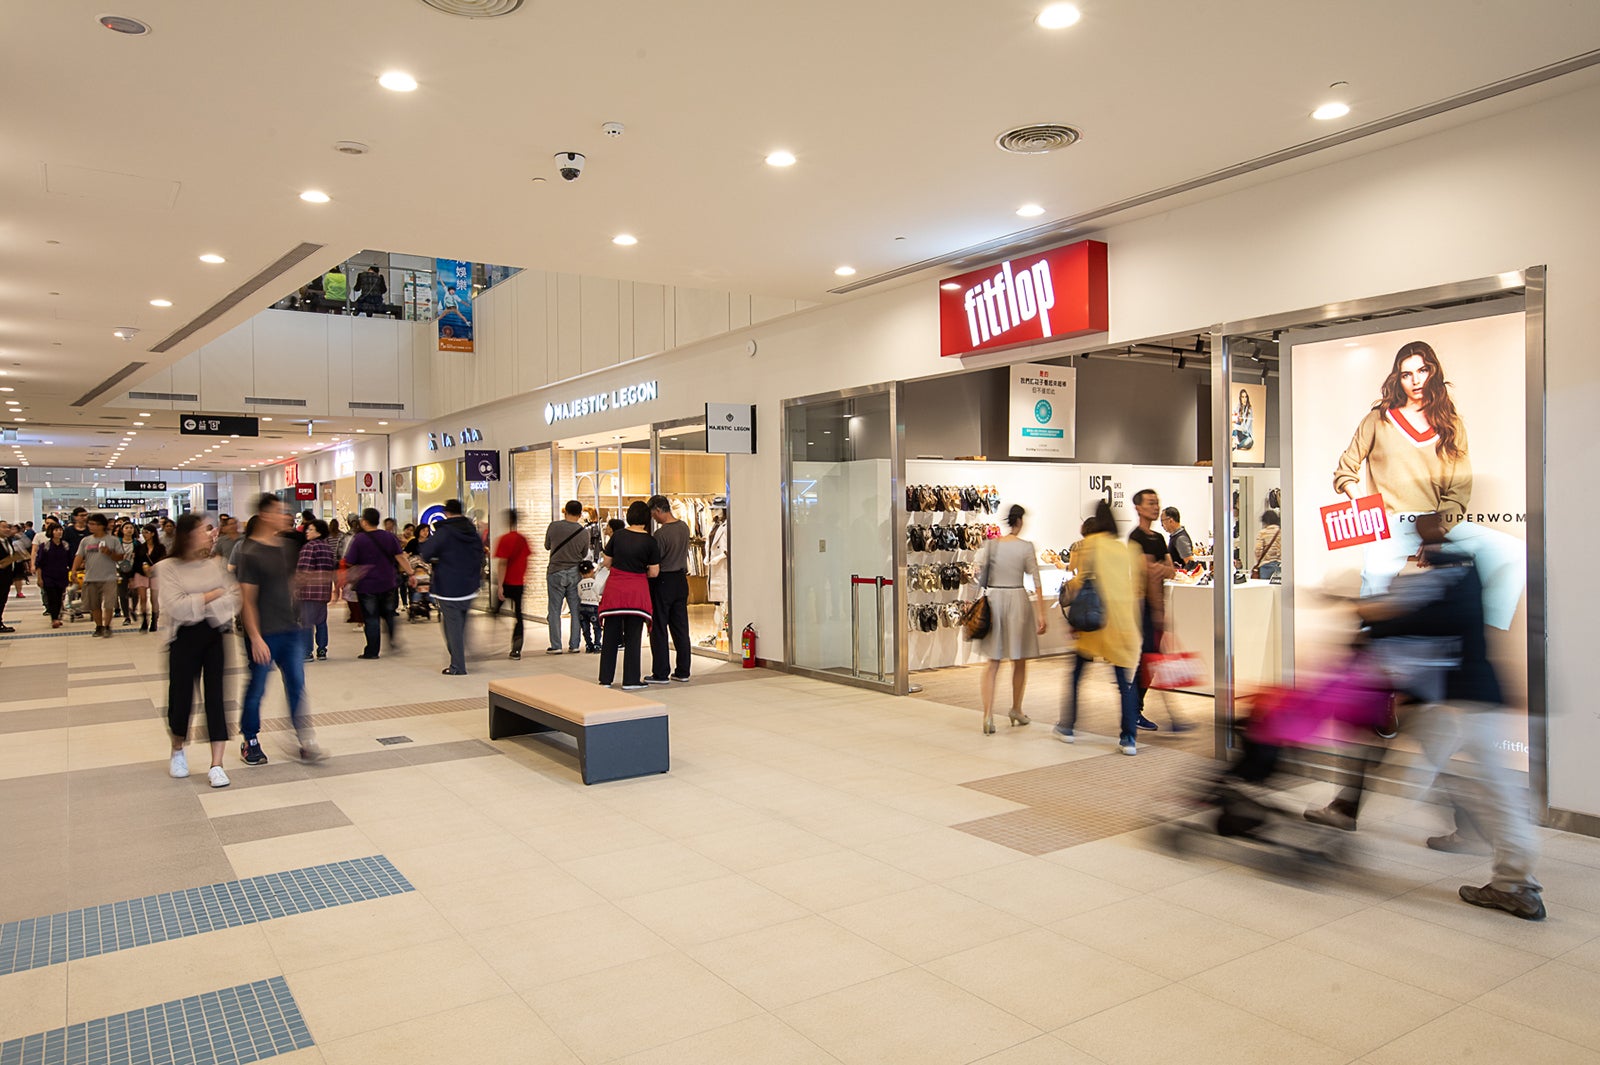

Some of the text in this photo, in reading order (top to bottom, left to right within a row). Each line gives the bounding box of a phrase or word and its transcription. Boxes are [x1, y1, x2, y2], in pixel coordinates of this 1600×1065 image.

[964, 259, 1055, 348] fitflop
[554, 380, 658, 421] MAJESTIC LEGON
[460, 427, 481, 445] sha
[1325, 498, 1386, 543] fitflop
